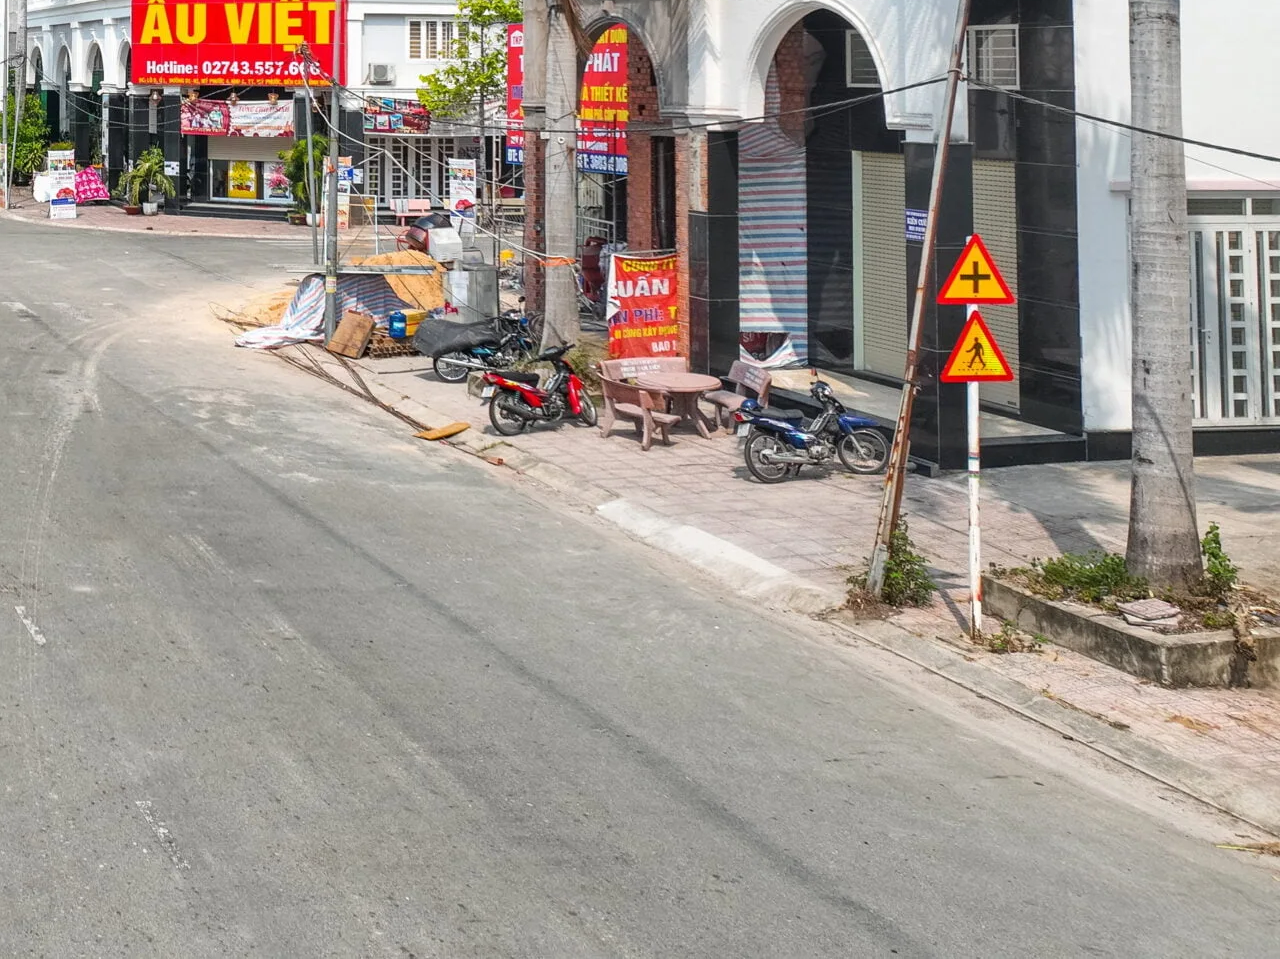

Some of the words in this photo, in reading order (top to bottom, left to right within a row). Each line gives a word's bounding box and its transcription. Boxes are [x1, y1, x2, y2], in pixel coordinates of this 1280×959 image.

[146, 60, 199, 75] Hotline:
[585, 48, 621, 73] PHÁT
[617, 272, 670, 298] UẤN
